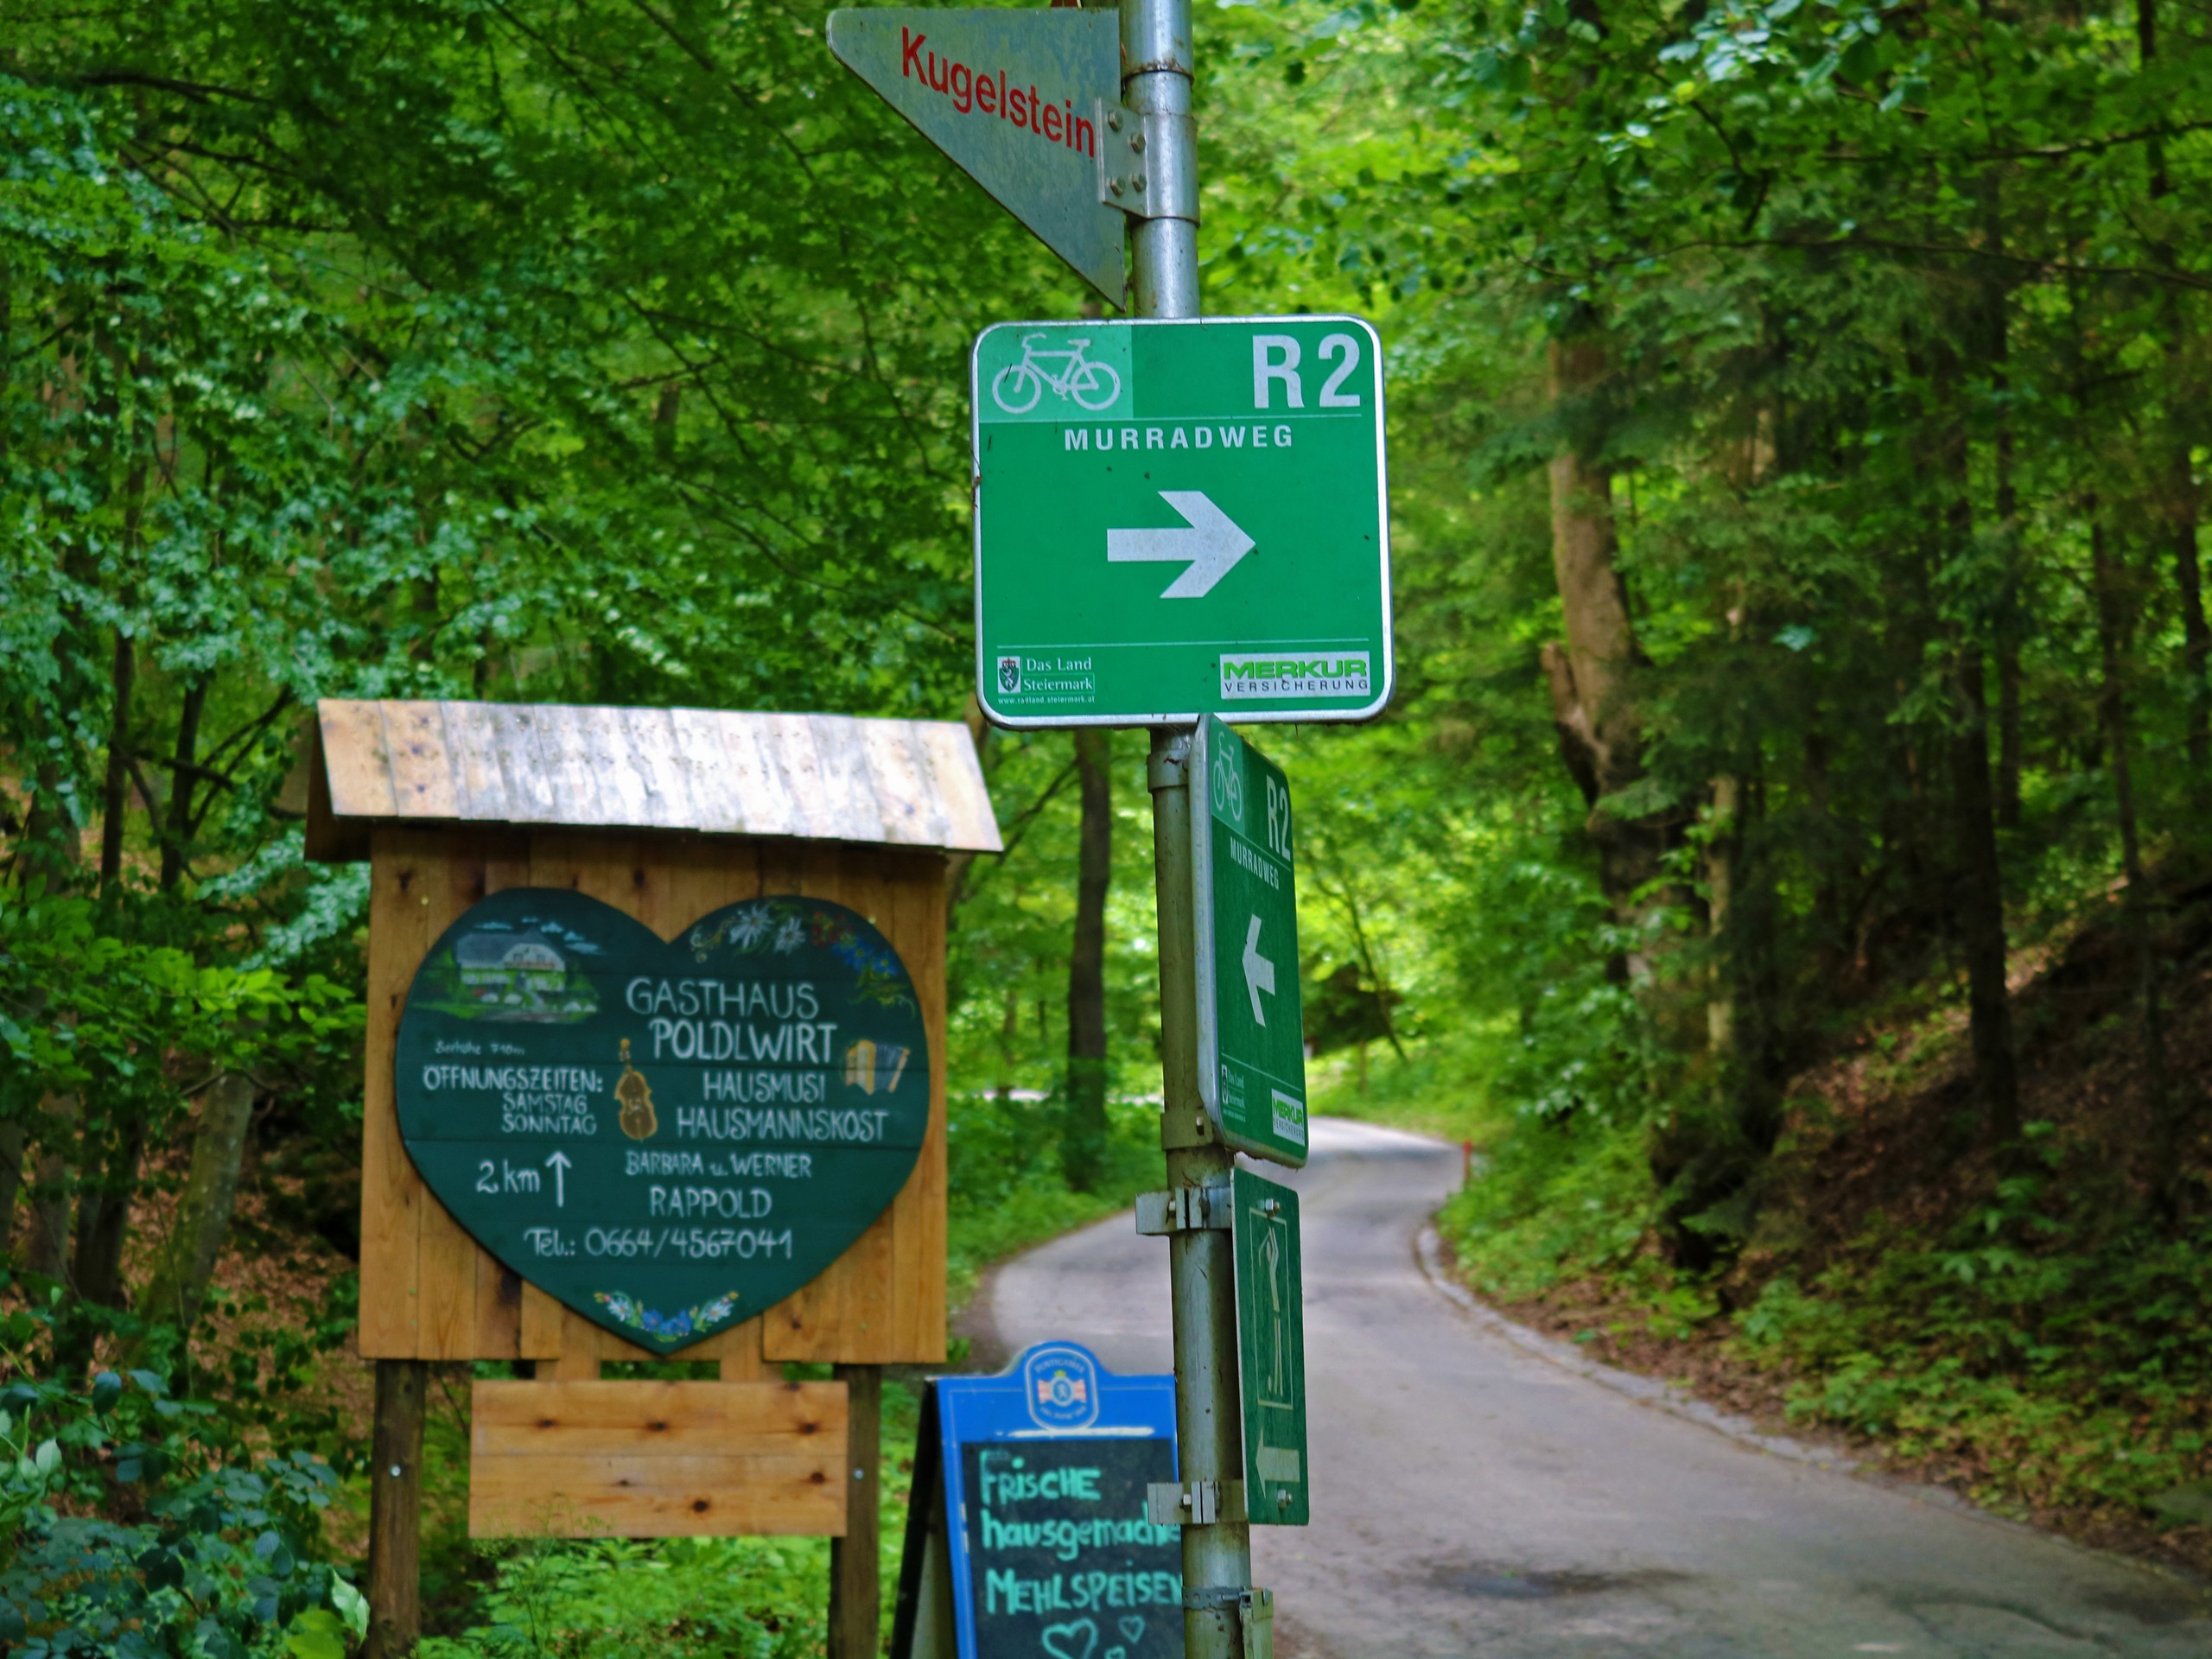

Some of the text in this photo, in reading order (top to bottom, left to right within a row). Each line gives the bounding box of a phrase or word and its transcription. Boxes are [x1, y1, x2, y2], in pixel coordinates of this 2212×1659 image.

[901, 26, 1095, 159] Kugelstein
[1065, 424, 1293, 451] MURRADWEG
[1027, 657, 1092, 671] Das Land
[1224, 659, 1368, 680] MERKUR
[998, 695, 1096, 704] www.radland.steiermark.at
[1023, 677, 1093, 691] Steiermark
[1224, 679, 1369, 692] VERSICHERUNG
[1266, 774, 1292, 862] R2
[1230, 836, 1280, 891] MURRADWEG
[626, 977, 820, 1020] GASTHAUS
[650, 1018, 837, 1064] POLDLWIRT
[502, 1091, 588, 1115] SAMSTAG
[702, 1071, 826, 1104] HAUSMUSI
[501, 1113, 598, 1136] SONNTAG
[677, 1107, 889, 1141] HAUSMANNSKOST
[1272, 1096, 1304, 1126] MERKUR
[475, 1159, 542, 1194] 2 km
[625, 1150, 705, 1177] BARBARA
[730, 1152, 813, 1179] WERNER
[649, 1185, 773, 1219] RAPPOLD
[584, 1227, 794, 1261] 0664/4567041
